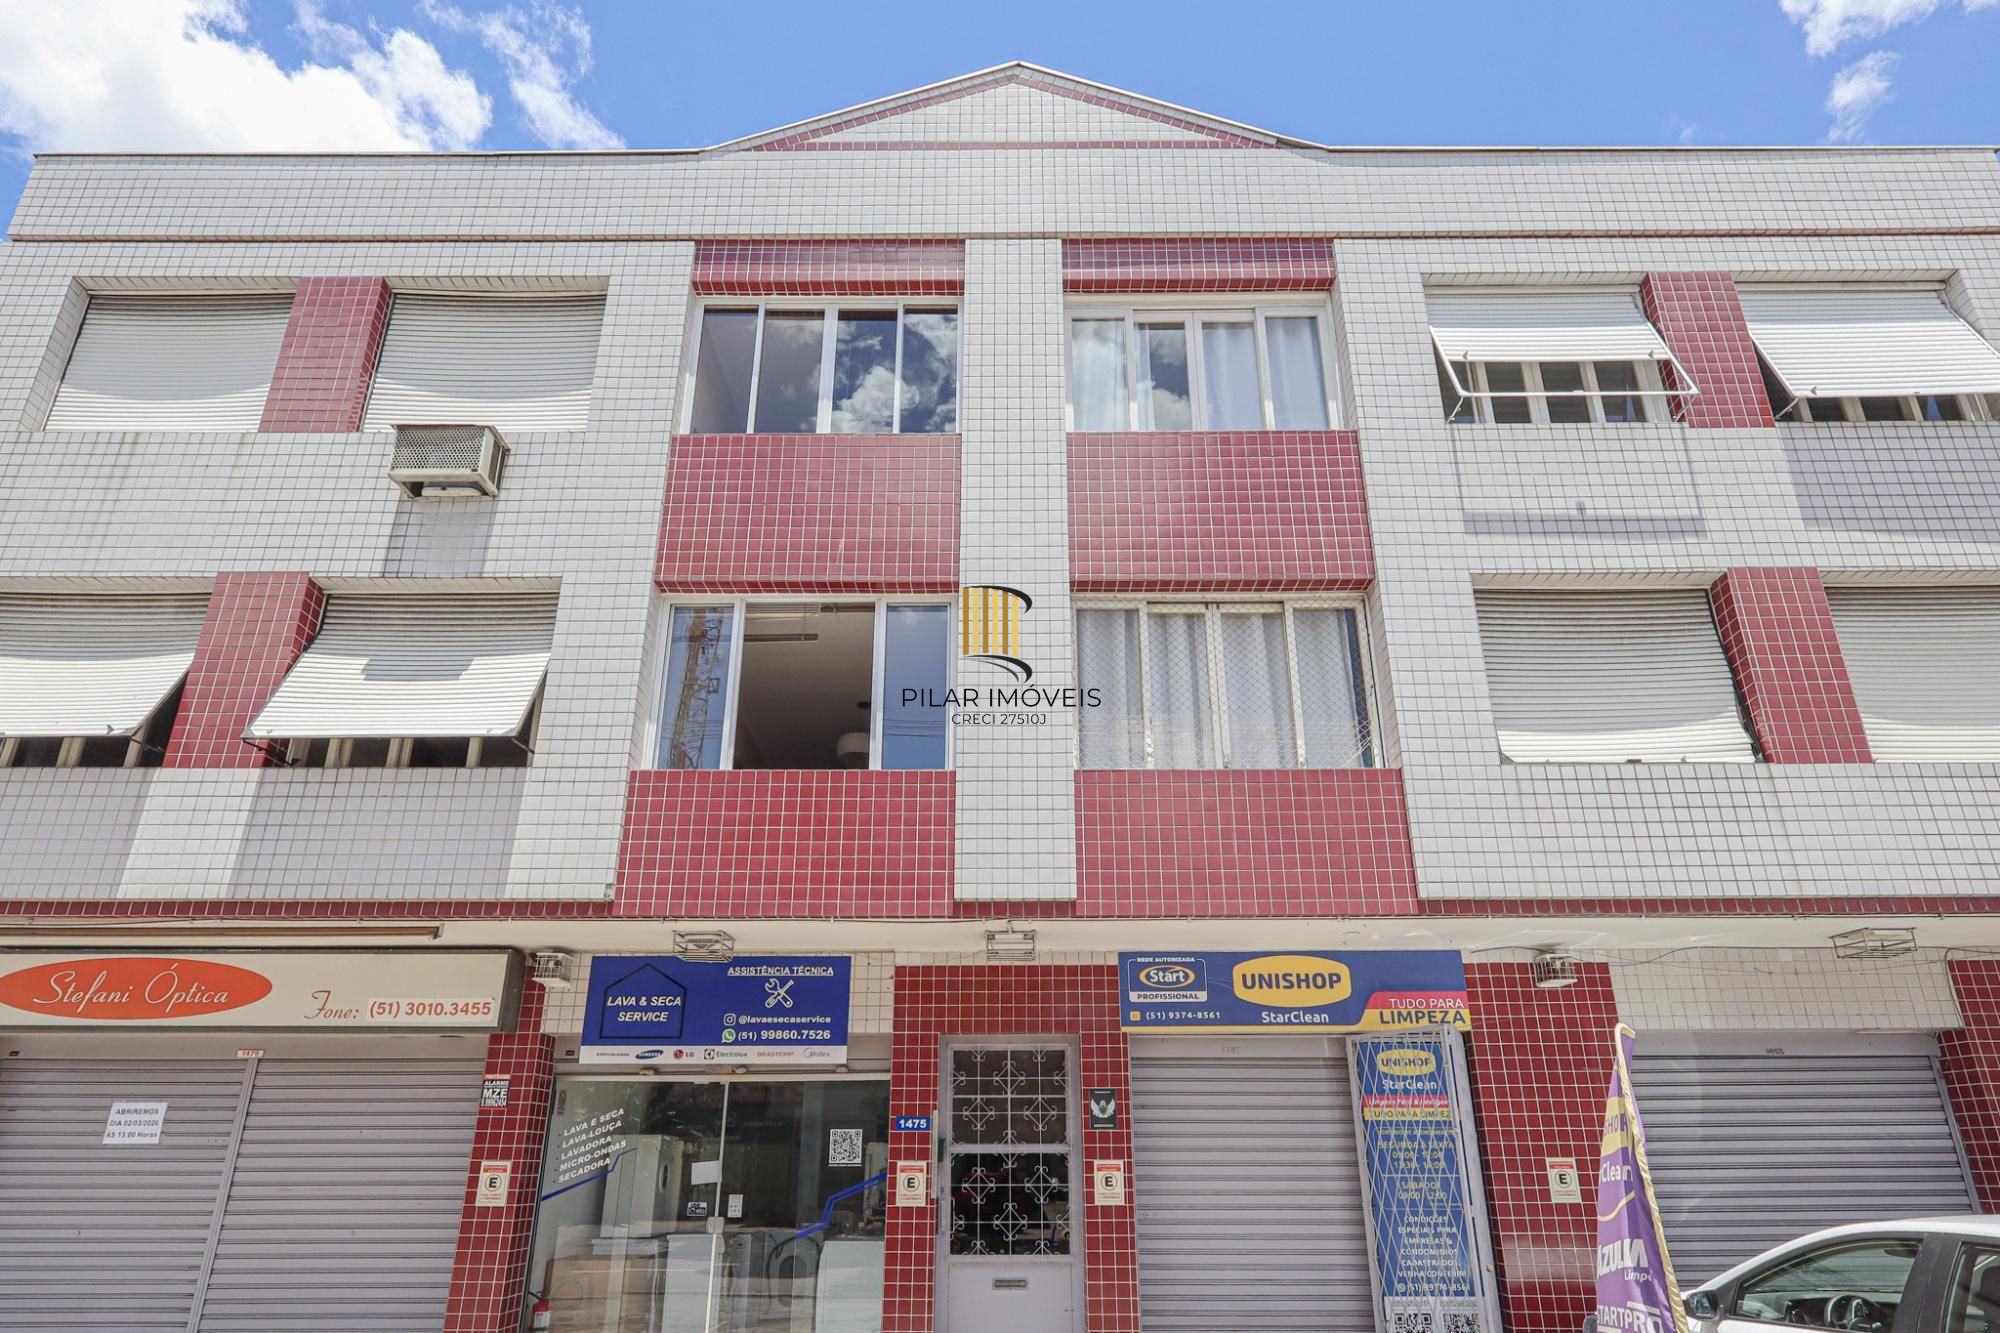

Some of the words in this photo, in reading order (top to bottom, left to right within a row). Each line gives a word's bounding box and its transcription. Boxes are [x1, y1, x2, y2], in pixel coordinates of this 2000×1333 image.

[727, 965, 790, 976] ASSISTÊNCIA
[792, 966, 834, 976] TÉCNICA
[1149, 969, 1186, 982] Start
[1241, 972, 1342, 990] UNISHOP
[33, 970, 134, 1013] Stefani
[145, 963, 229, 1013] Óptica
[304, 990, 359, 1019] Fone:
[370, 1001, 400, 1019] (51)
[405, 1001, 491, 1017] 3010.3455
[607, 996, 636, 1006] LAVA
[639, 996, 648, 1006] &
[650, 996, 681, 1006] SECA
[1389, 998, 1427, 1009] TUDO
[1429, 998, 1465, 1009] PARA
[617, 1012, 669, 1022] SERVICE
[738, 1015, 831, 1025] @lavaesecaservice
[1146, 1011, 1166, 1021] (51)
[1168, 1011, 1221, 1020] 9374-8561
[1261, 1011, 1329, 1024] StarClean
[1379, 1010, 1467, 1025] LIMPEZA
[738, 1031, 757, 1041] (51)
[760, 1030, 831, 1040] 99860.7526
[483, 1088, 509, 1099] MZE
[1420, 1110, 1451, 1118] LIMPEZ
[563, 1121, 588, 1137] LAVA
[590, 1118, 597, 1127] E
[600, 1107, 625, 1123] SECA
[899, 1119, 927, 1129] 1475
[562, 1120, 622, 1148] LAVA-LOUÇA
[561, 1135, 612, 1160] LAVADORA
[559, 1140, 627, 1171] MICRO-ONDAS
[558, 1157, 611, 1183] SECADORA
[1600, 1161, 1633, 1183] Clean
[489, 1177, 498, 1188] E
[907, 1177, 916, 1189] E
[1104, 1176, 1114, 1188] E
[1558, 1173, 1569, 1185] E
